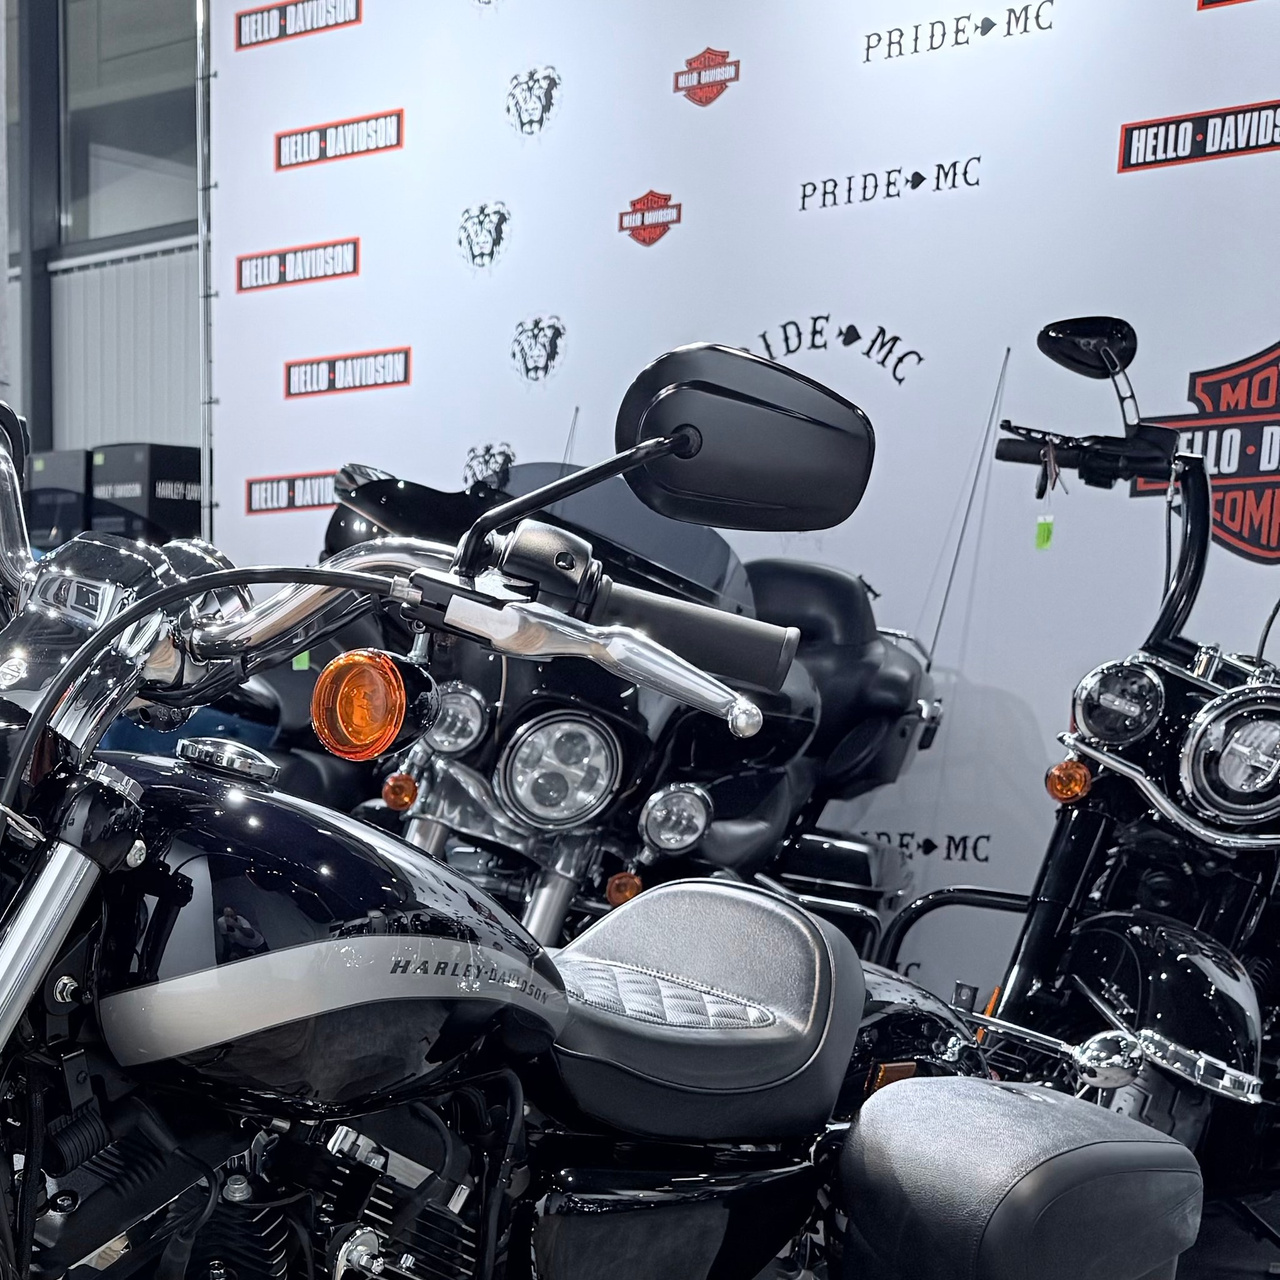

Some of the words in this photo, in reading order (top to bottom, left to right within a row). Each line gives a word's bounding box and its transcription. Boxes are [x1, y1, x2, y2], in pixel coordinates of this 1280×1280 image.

[241, 9, 280, 45] HELLO
[286, 0, 357, 35] DAVIDSON
[862, 14, 972, 64] PRIDE
[1003, 0, 1054, 38] MC
[677, 72, 699, 89] HELLO
[700, 64, 737, 85] DAVIDSON
[280, 130, 320, 167] HELLO
[326, 115, 398, 158] DAVIDSON
[1130, 122, 1193, 164] HELLO
[798, 167, 903, 212] PRIDE
[932, 155, 982, 192] MC
[242, 255, 280, 288] HELLO
[285, 242, 355, 282] DAVIDSON
[757, 312, 831, 361] IDE
[861, 325, 925, 386] MC
[290, 361, 329, 394] HELLO
[335, 352, 405, 389] DAVIDSON
[1219, 366, 1280, 412] MO
[251, 480, 288, 510] HELLO
[294, 476, 338, 507] DAVID
[942, 835, 991, 863] MC
